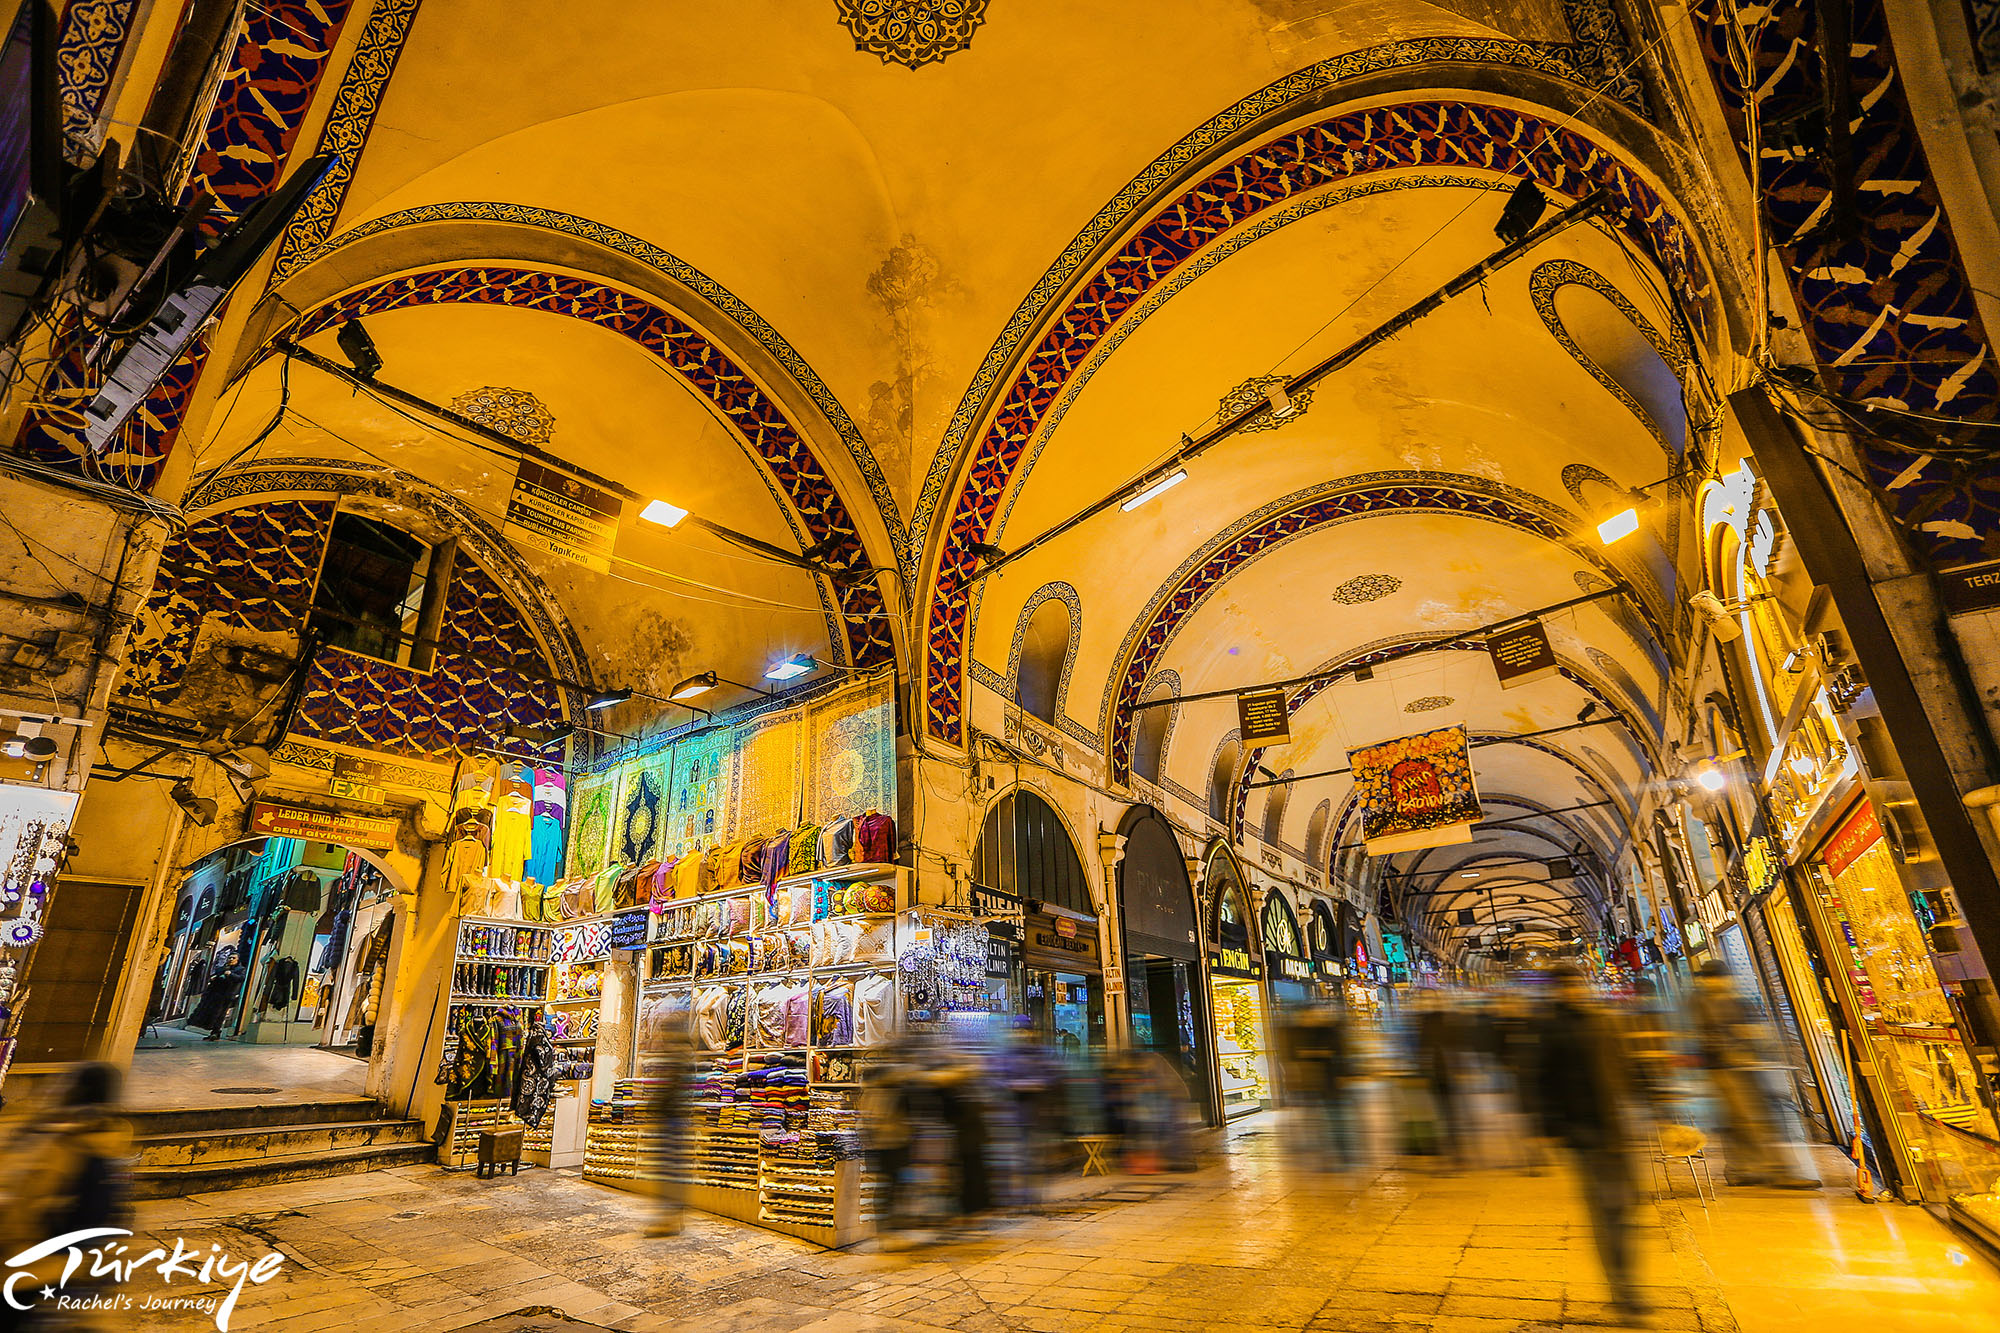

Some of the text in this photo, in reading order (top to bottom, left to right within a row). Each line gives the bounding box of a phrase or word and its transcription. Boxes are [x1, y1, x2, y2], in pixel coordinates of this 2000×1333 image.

[526, 508, 552, 524] TOURIST
[552, 519, 566, 530] BUS
[566, 525, 592, 540] PARKING
[1964, 570, 2000, 589] TERZ
[333, 780, 384, 801] EXIT
[278, 809, 392, 834] LEDER UND PELZ BAZAAR
[273, 826, 391, 848] DERİ GİYİM ÇARŞISI
[988, 941, 1006, 957] LTIN
